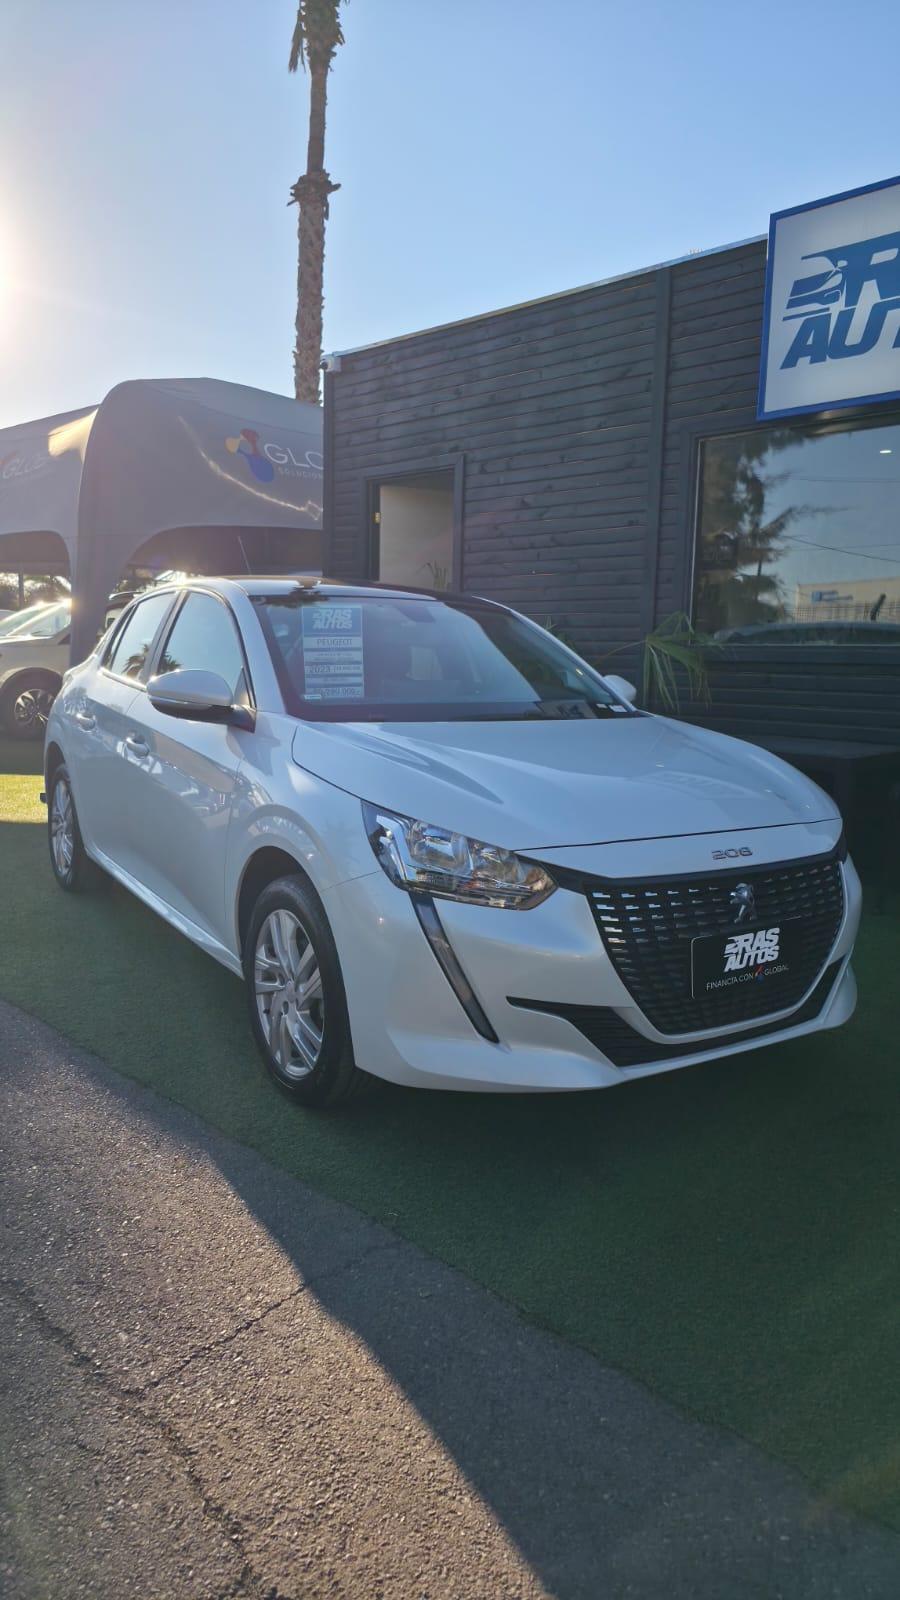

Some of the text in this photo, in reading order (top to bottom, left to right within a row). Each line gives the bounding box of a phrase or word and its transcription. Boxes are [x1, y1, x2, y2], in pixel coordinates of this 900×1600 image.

[312, 619, 352, 630] AUTOS
[316, 638, 353, 646] PEUGEOT
[724, 946, 780, 972] AUTOS
[706, 964, 789, 991] FINANCIA CON GLOBAL
